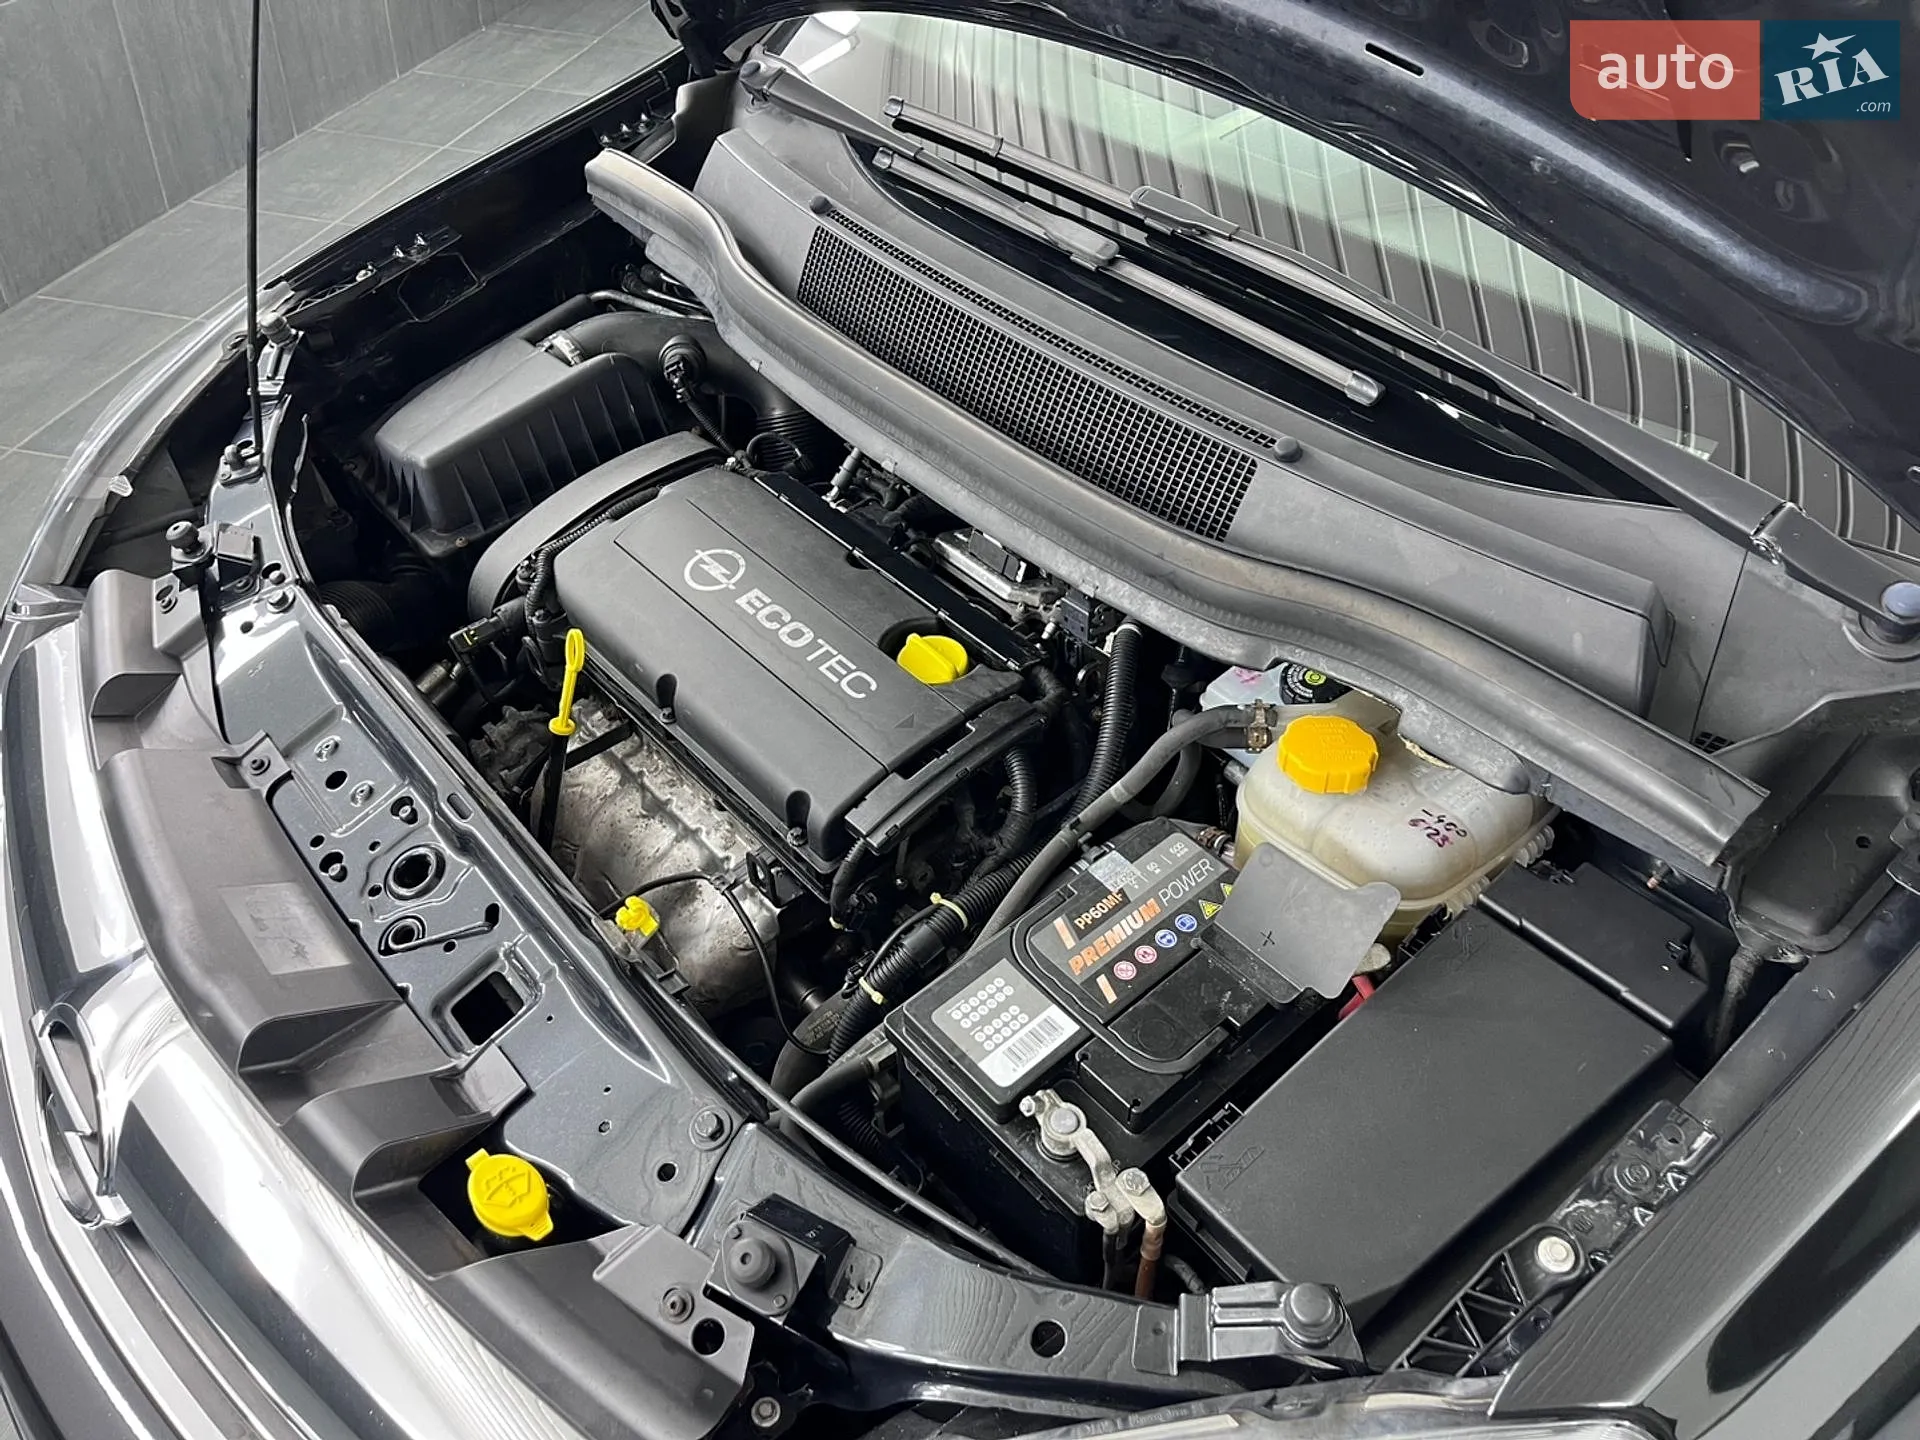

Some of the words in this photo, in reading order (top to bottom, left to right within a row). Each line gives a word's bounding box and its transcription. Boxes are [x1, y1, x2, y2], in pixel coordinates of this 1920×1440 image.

[735, 588, 878, 699] ECOTEC
[1068, 897, 1162, 976] PREMIUM
[1158, 858, 1215, 907] POWER
